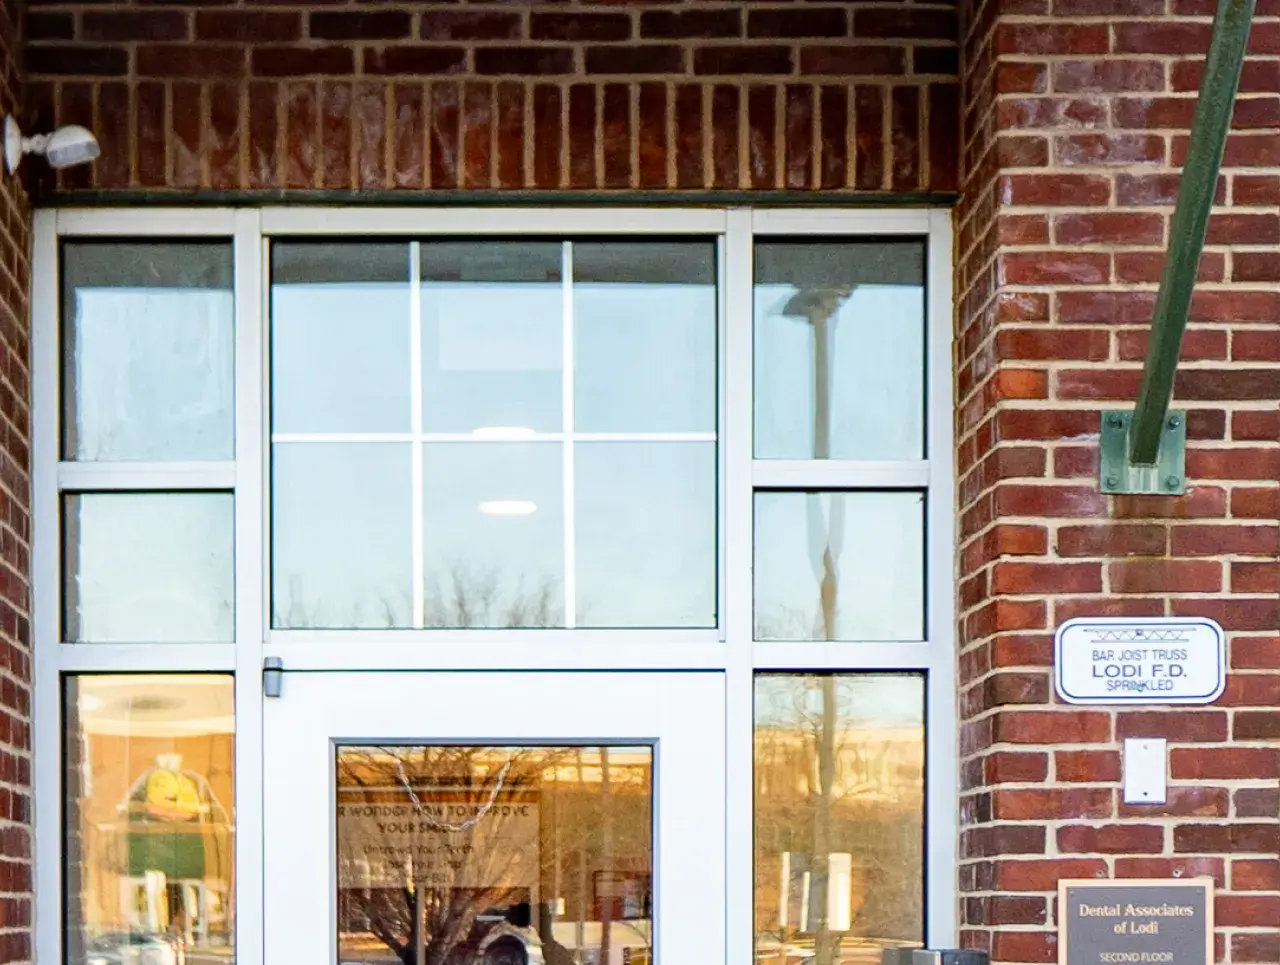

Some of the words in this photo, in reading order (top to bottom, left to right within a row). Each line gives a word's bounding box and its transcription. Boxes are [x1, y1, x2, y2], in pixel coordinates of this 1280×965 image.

[1092, 650, 1115, 661] BAR
[1118, 650, 1149, 661] JOIST
[1152, 649, 1188, 661] TRUSS
[1092, 664, 1142, 678] LODI
[1152, 664, 1188, 678] F.D.
[1106, 680, 1174, 691] SPRINKLED
[449, 806, 466, 817] TO
[378, 822, 416, 834] YOUR
[1079, 904, 1120, 917] Dental
[1124, 903, 1194, 917] Associates
[1113, 921, 1127, 934] of
[1130, 921, 1159, 934] Lodi
[1099, 952, 1140, 963] SECOND
[1140, 952, 1174, 963] FLOOR
